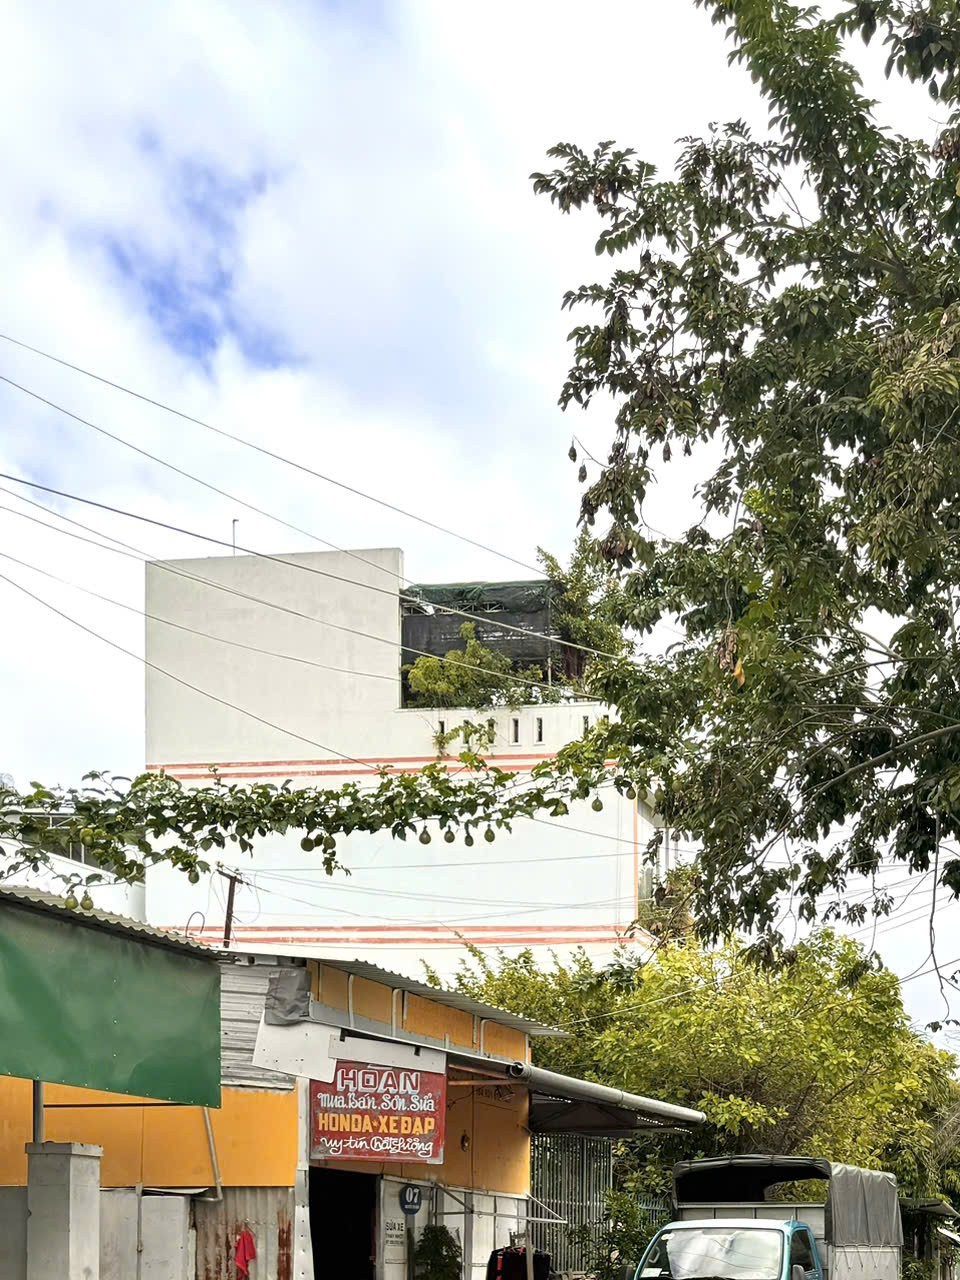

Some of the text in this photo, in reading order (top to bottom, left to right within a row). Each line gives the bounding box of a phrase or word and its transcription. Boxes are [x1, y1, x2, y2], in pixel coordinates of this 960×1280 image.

[319, 1113, 435, 1136] HONDA XE ĐẠP
[406, 1187, 420, 1203] 07
